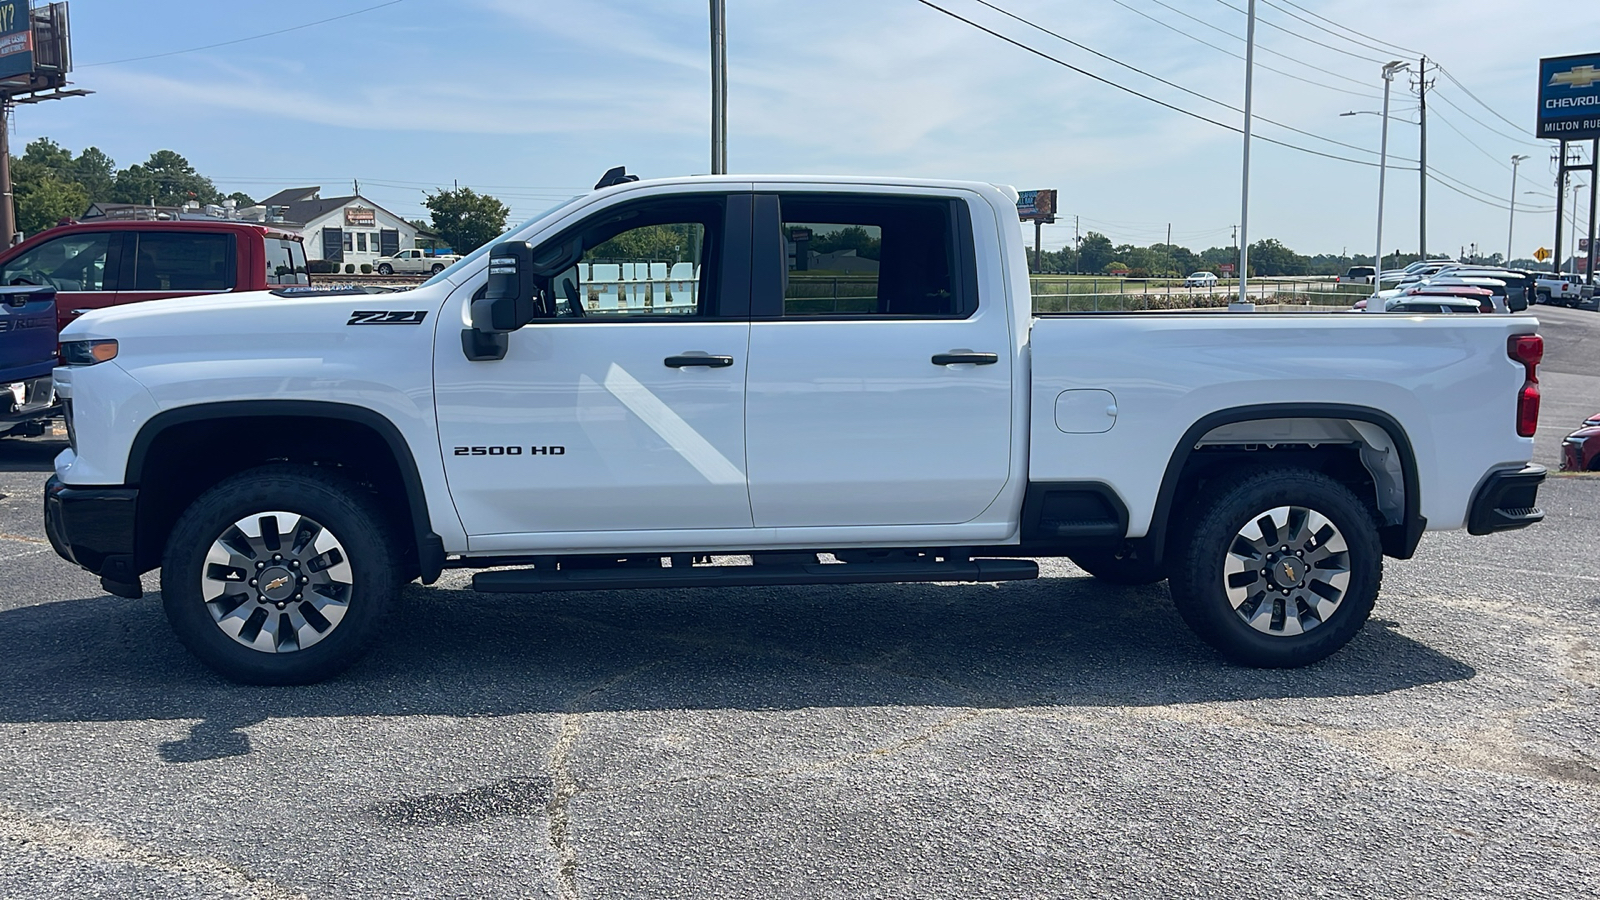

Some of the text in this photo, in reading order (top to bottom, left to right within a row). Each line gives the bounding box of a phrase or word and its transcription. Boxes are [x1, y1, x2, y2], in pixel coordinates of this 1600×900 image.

[1544, 121, 1579, 132] MILTON
[346, 310, 429, 326] Z71
[454, 446, 565, 456] 2500 HD
